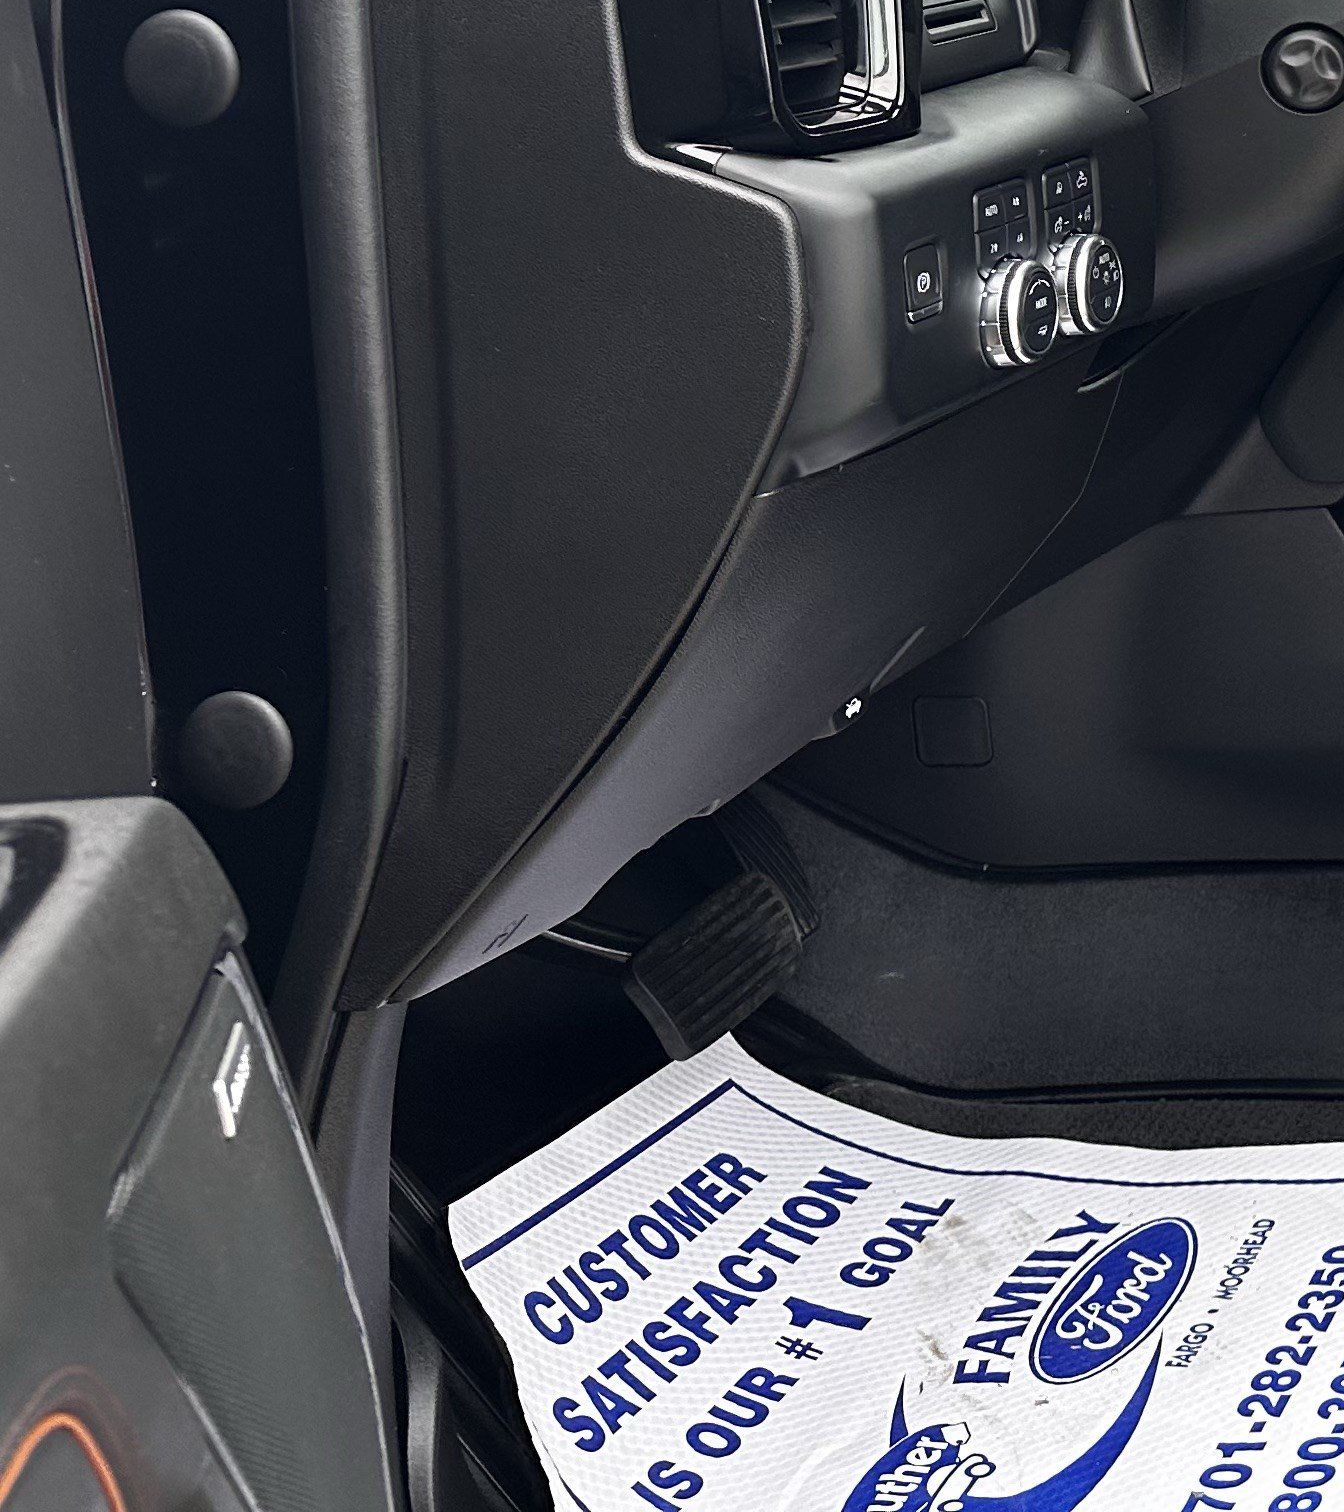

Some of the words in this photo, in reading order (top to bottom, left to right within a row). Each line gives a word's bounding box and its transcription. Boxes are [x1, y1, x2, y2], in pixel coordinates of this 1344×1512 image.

[524, 1153, 768, 1345] CUSTOMER
[552, 1166, 873, 1452] SATISFACTION
[952, 1209, 1121, 1384] FAMILY
[1055, 1250, 1173, 1350] Ford
[1165, 1322, 1214, 1368] FARGO
[1213, 1219, 1275, 1300] MOORHEAD
[631, 1460, 704, 1512] IS
[686, 1366, 800, 1458] OUR
[839, 1198, 956, 1288] GOAL
[866, 1436, 948, 1512] uther
